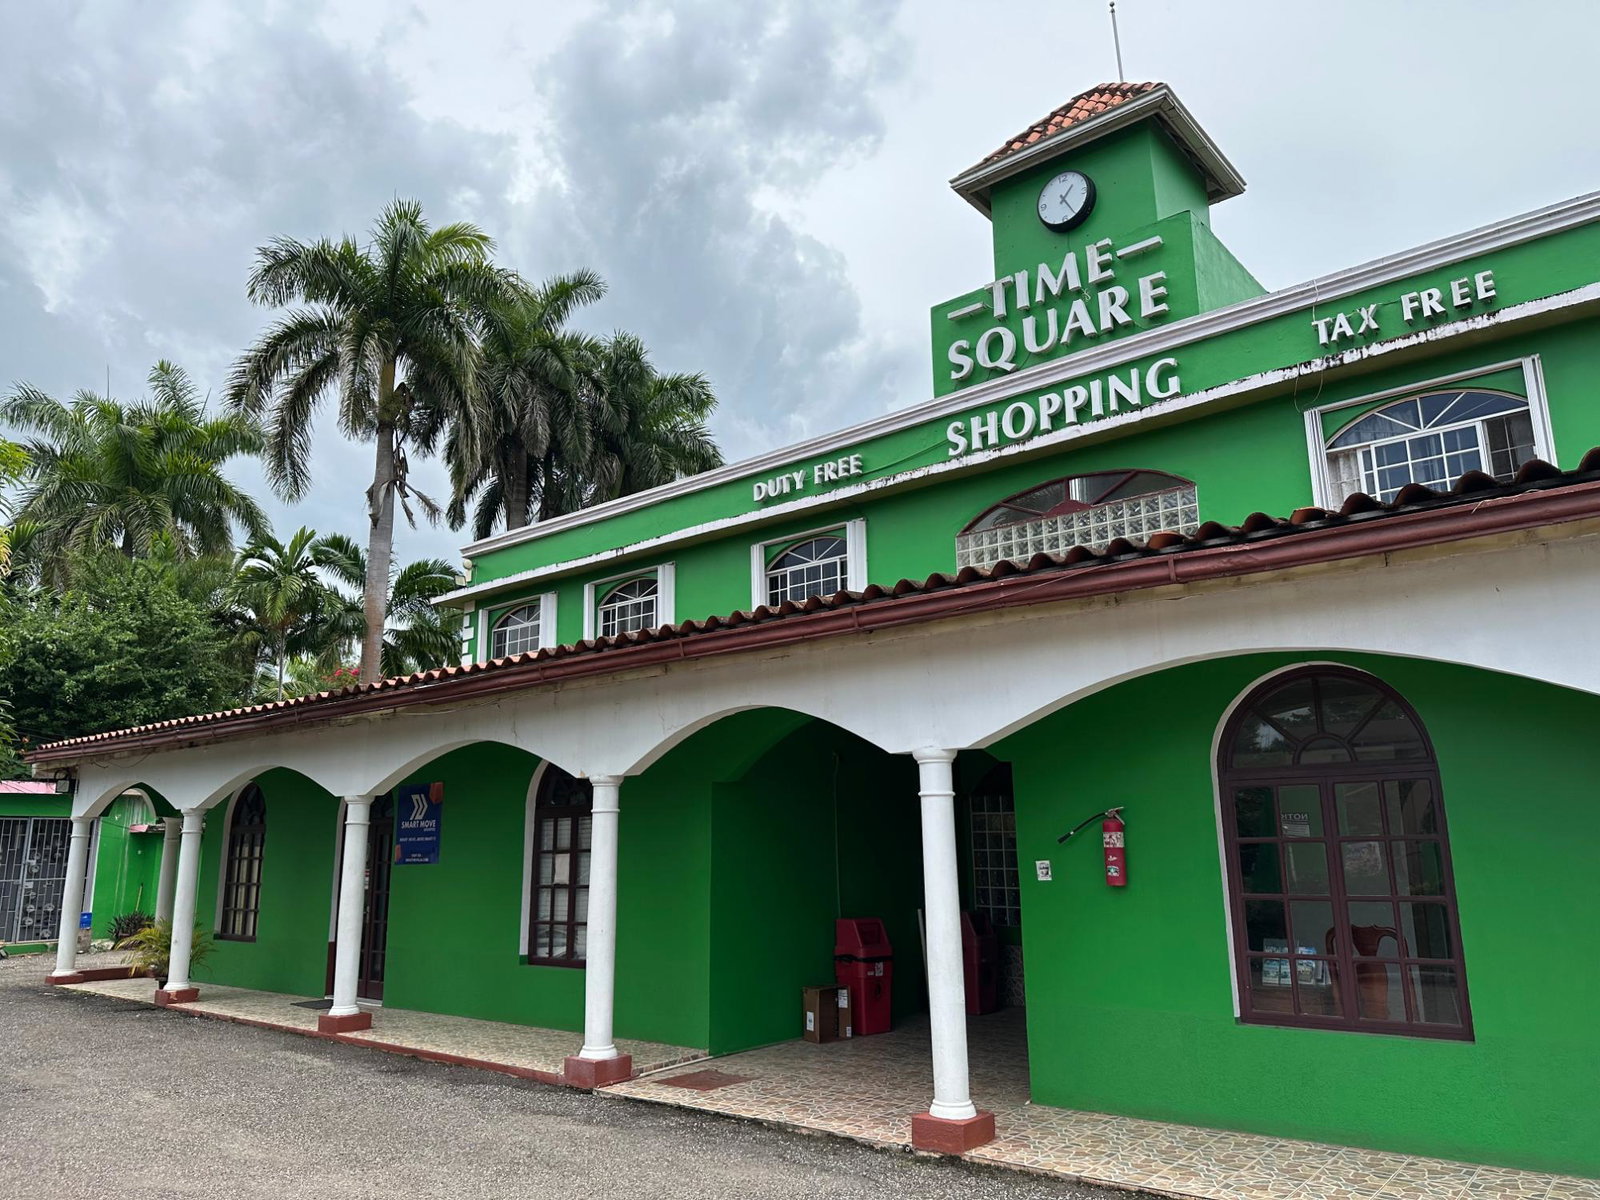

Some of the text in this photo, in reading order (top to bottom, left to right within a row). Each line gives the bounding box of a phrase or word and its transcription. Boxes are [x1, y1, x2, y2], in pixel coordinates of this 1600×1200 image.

[1040, 203, 1048, 211] 9
[1058, 174, 1068, 183] 12
[984, 237, 1115, 321] TIME
[1311, 269, 1497, 346] TAX FREE
[947, 270, 1171, 380] SQUARE
[946, 357, 1181, 457] SHOPPING
[753, 453, 863, 502] DUTY FREE
[401, 819, 436, 829] SMART MOVE
